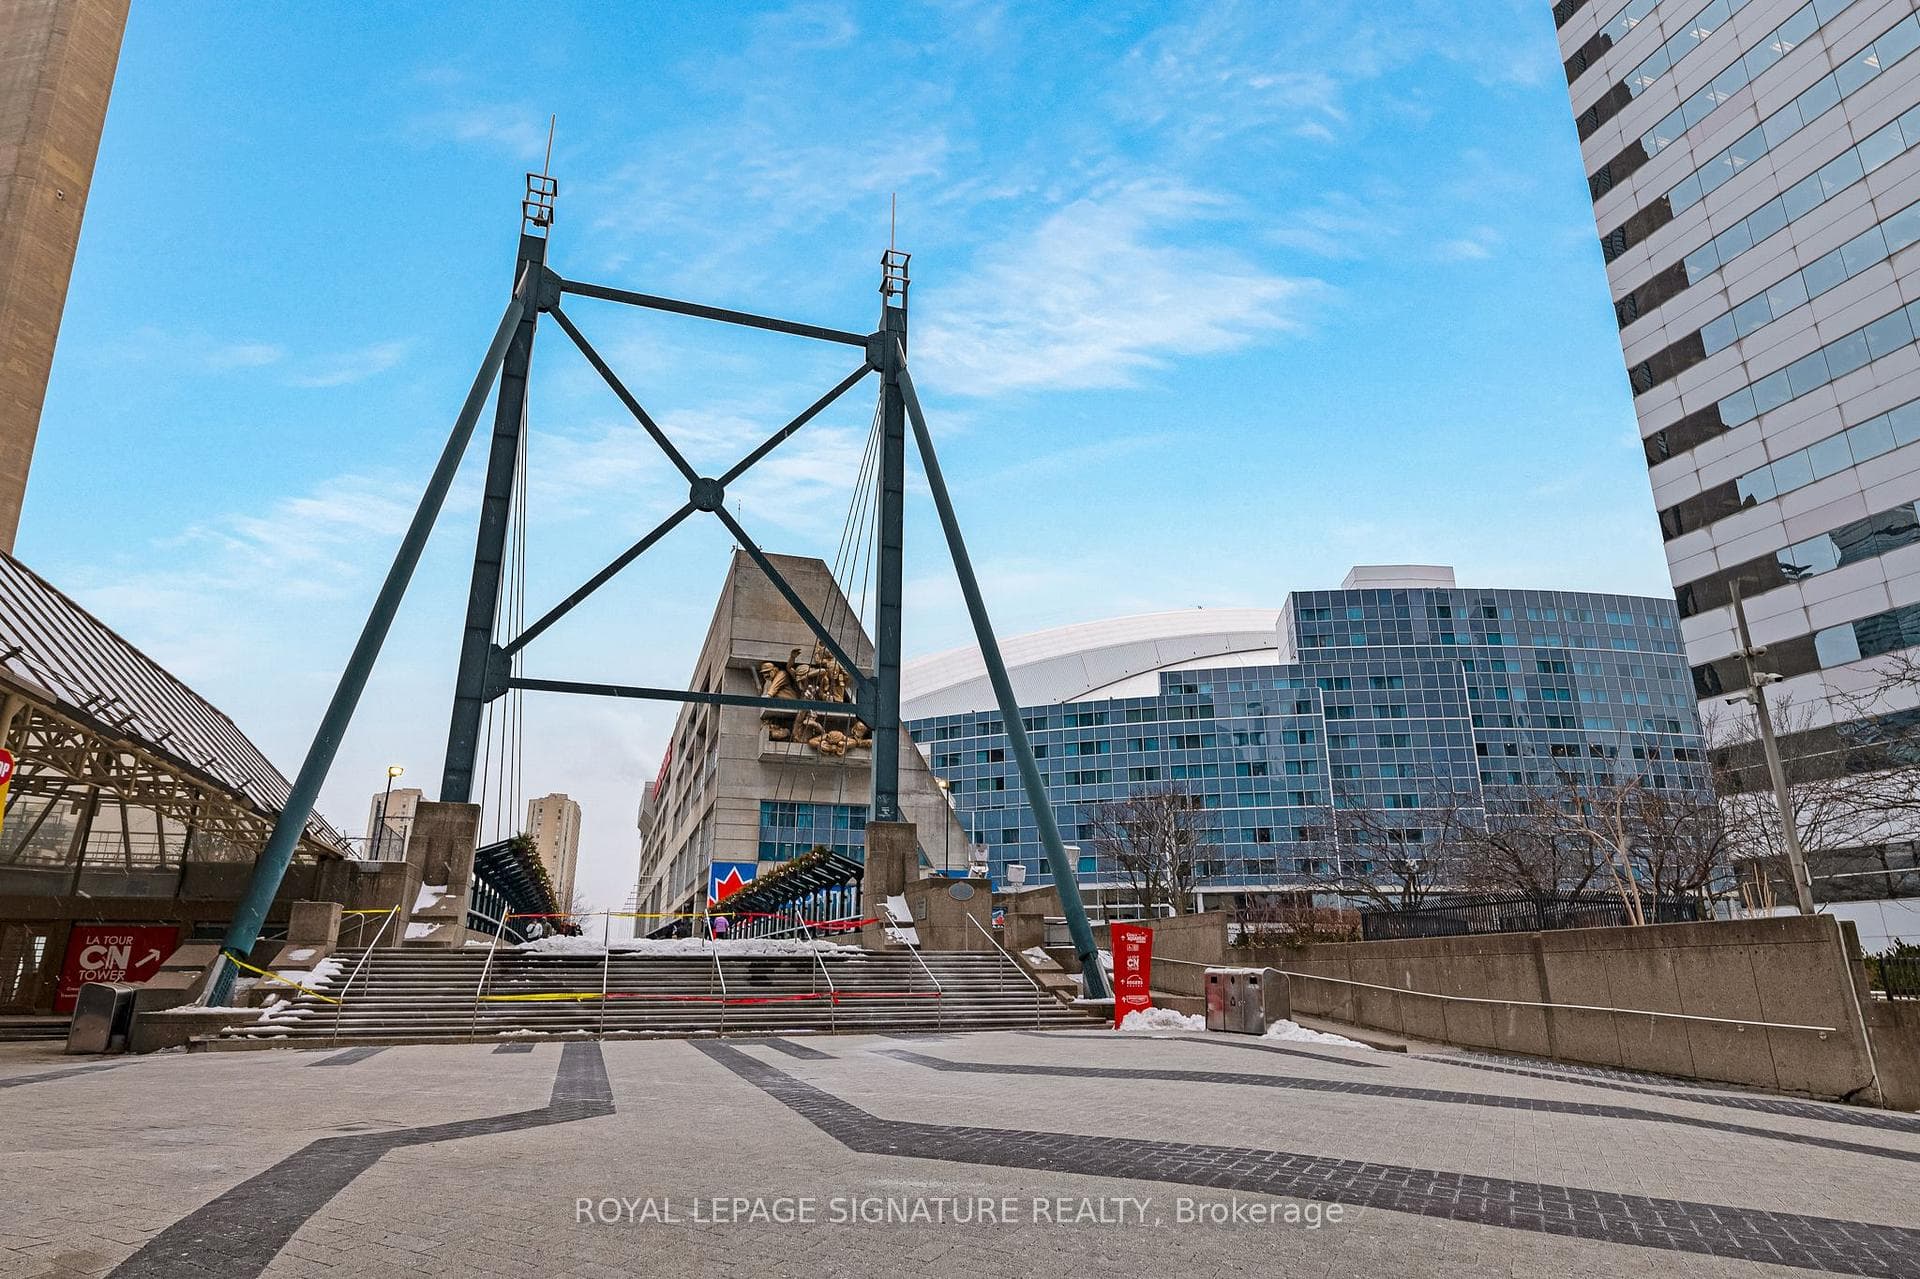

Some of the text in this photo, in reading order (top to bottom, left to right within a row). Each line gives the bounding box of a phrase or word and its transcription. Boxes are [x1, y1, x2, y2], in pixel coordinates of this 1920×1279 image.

[86, 936, 134, 945] LA TOUR
[79, 945, 131, 969] CN
[1127, 958, 1139, 967] CN
[79, 970, 126, 981] TOWER
